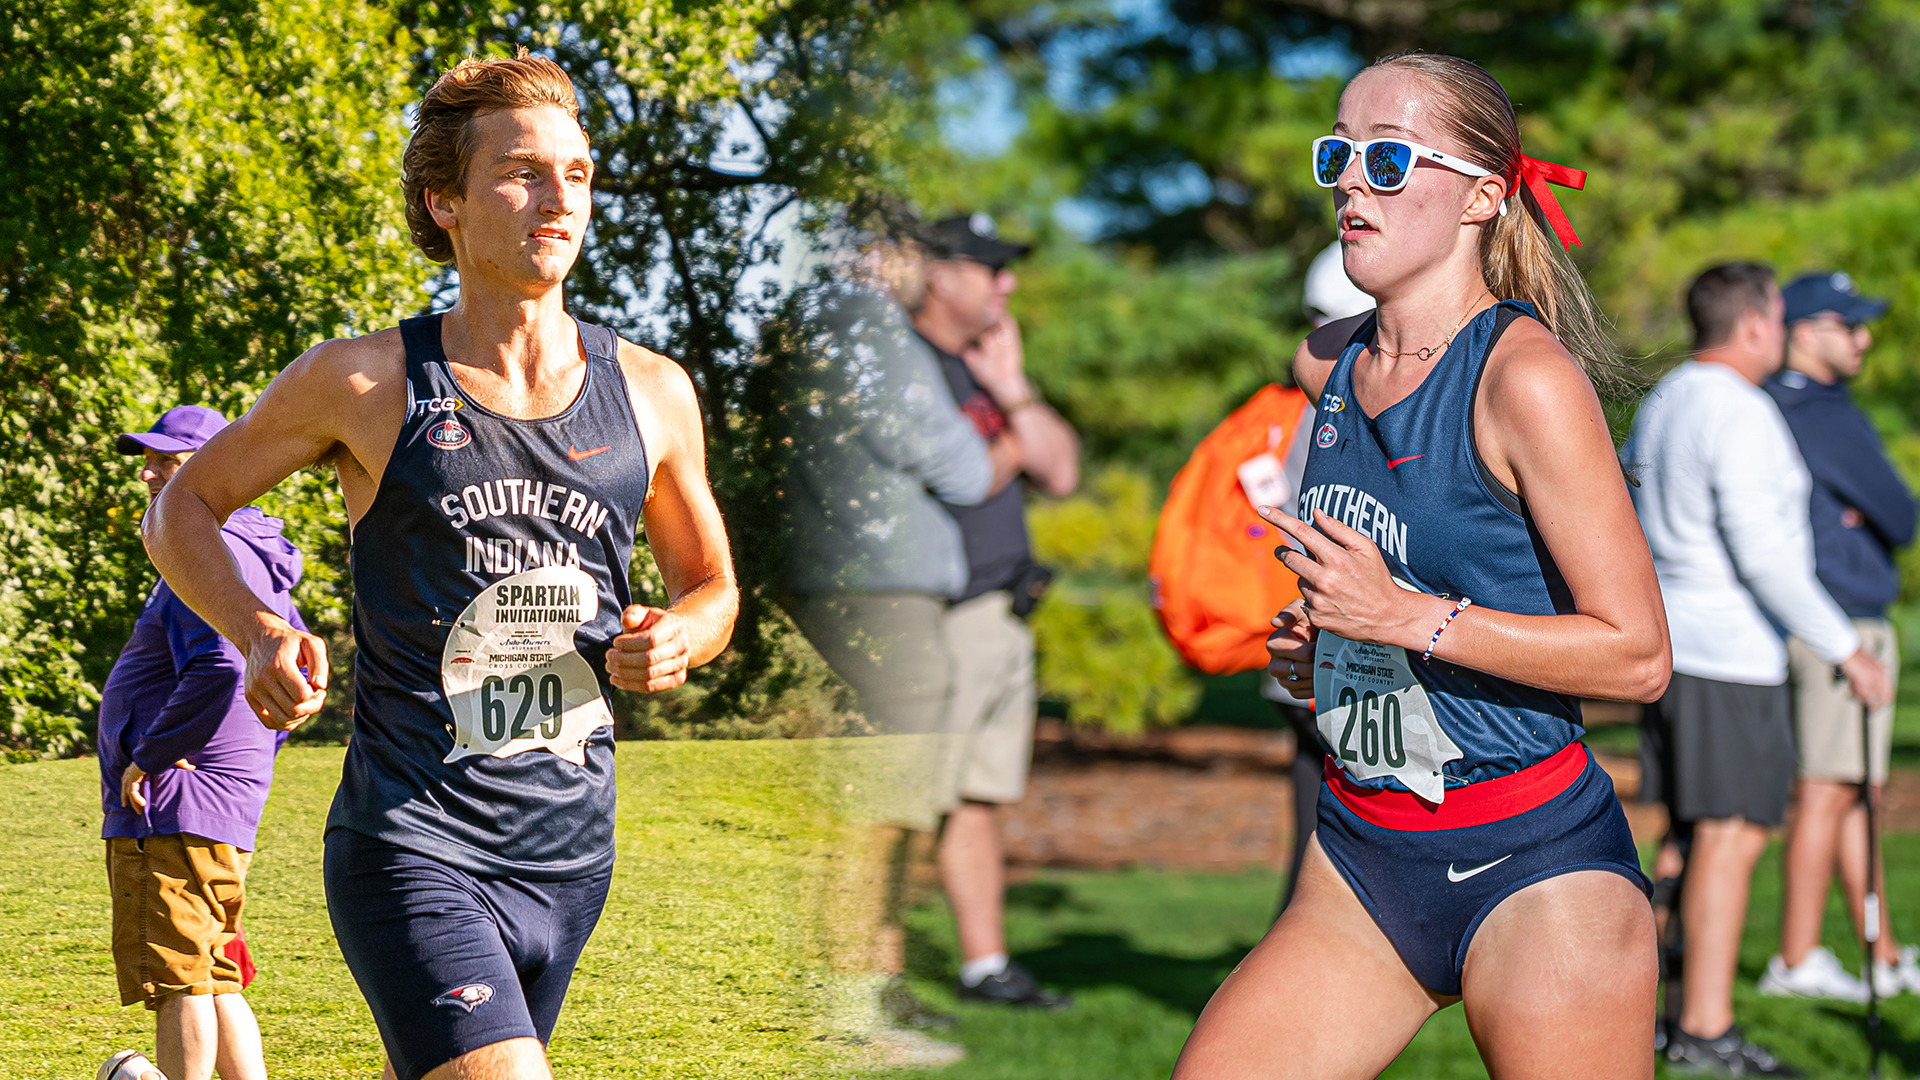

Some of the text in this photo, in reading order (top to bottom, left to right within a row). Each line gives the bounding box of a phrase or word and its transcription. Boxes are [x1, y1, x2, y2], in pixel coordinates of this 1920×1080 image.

[417, 397, 455, 415] TCG
[441, 478, 609, 539] SOUTHERN
[466, 536, 580, 574] INDIANA
[496, 585, 581, 606] SPARTAN
[495, 609, 581, 623] INVITATIONAL
[499, 638, 551, 646] Auto-Owners
[488, 653, 553, 663] MICHIGAN STATE
[1345, 661, 1376, 676] MICHIGAN
[1377, 667, 1396, 679] STATE
[1345, 673, 1395, 687] CROSS COUNTRY
[481, 673, 563, 742] 629
[1338, 686, 1407, 769] 260
